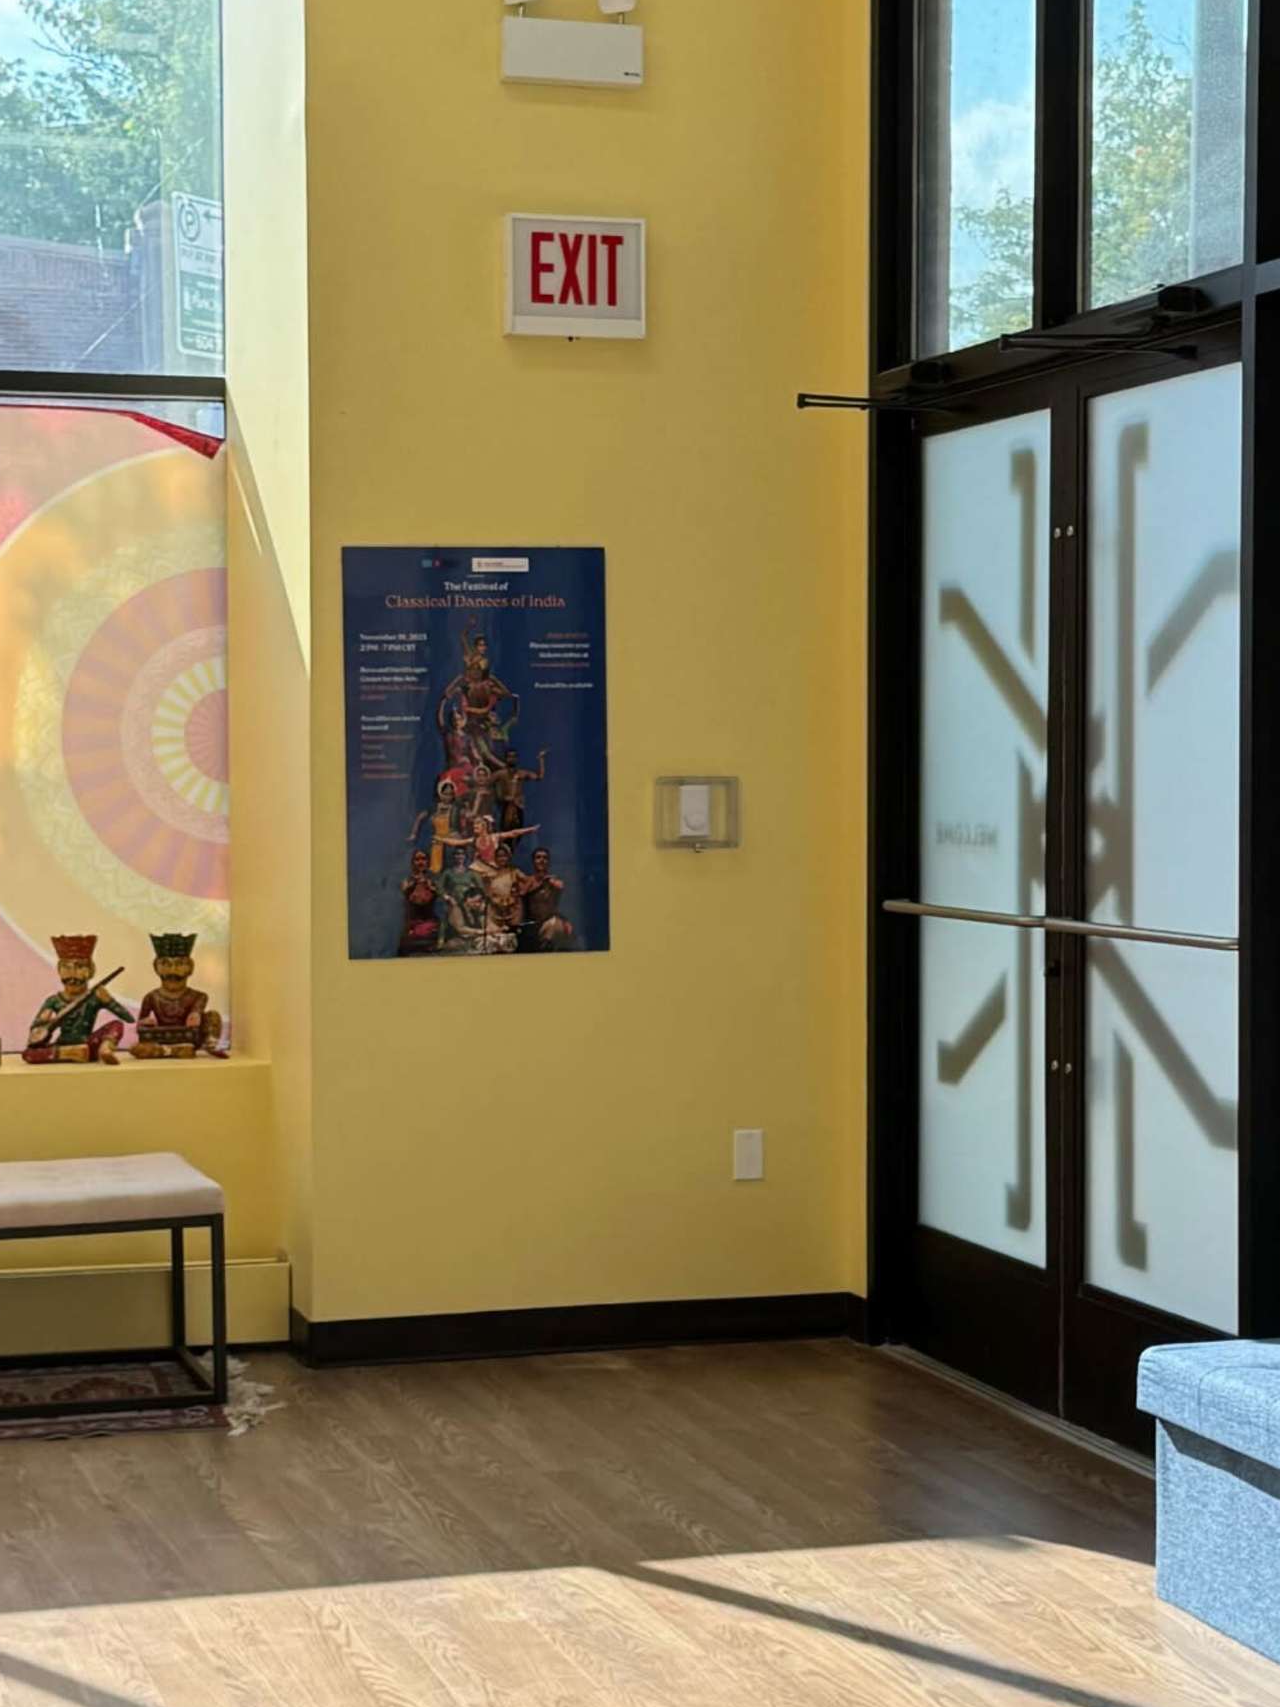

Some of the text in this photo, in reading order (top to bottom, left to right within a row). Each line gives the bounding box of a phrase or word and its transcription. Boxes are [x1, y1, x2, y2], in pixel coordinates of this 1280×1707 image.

[530, 231, 624, 307] EXIT
[444, 581, 509, 591] The Festival of
[385, 594, 566, 608] Classical Dances of India
